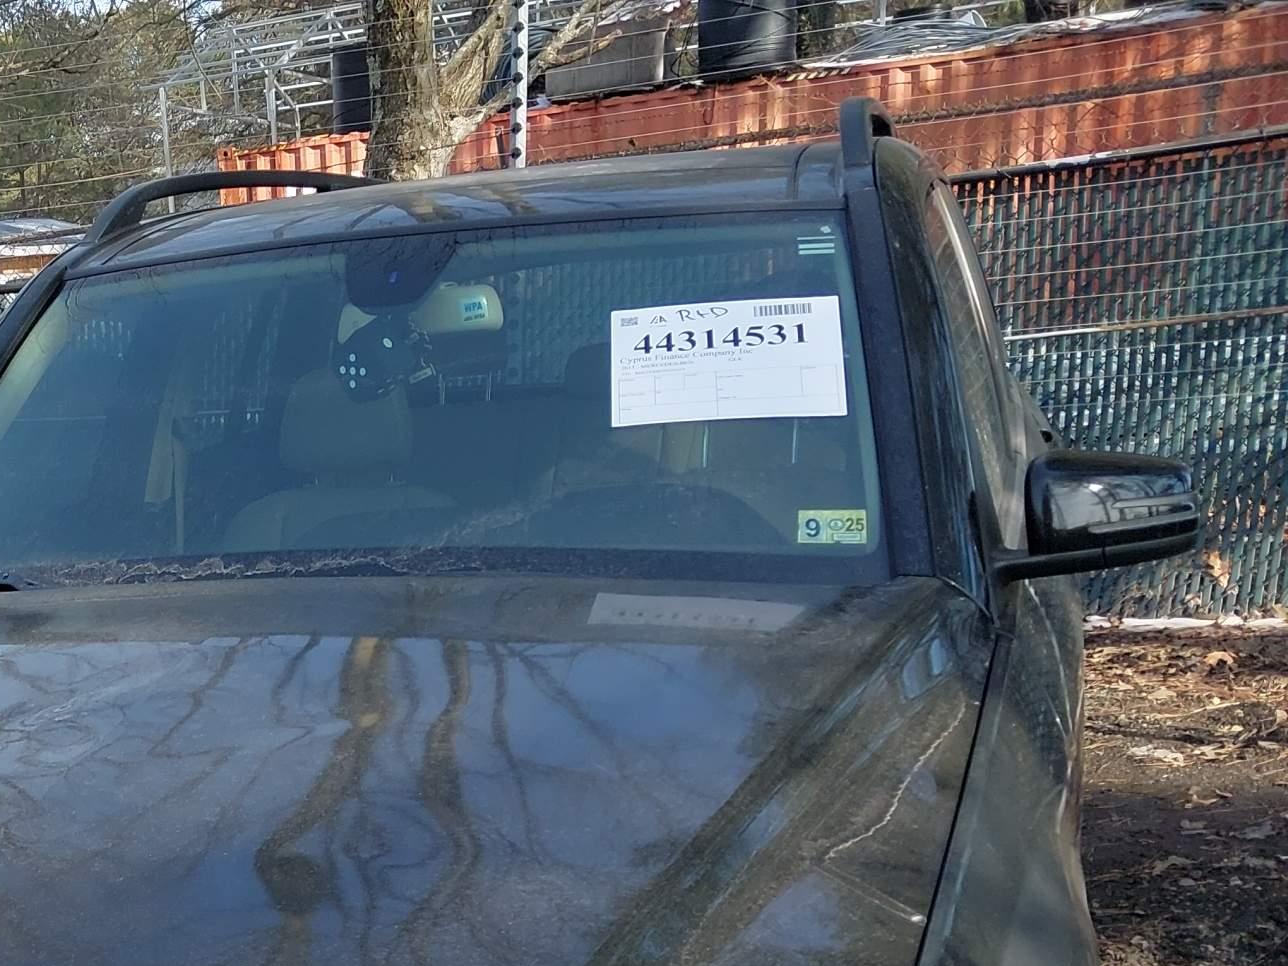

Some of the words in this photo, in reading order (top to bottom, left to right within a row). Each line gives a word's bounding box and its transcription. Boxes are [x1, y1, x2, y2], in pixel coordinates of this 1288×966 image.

[634, 322, 809, 354] 44314531
[805, 518, 820, 537] 9
[845, 518, 864, 531] 25
